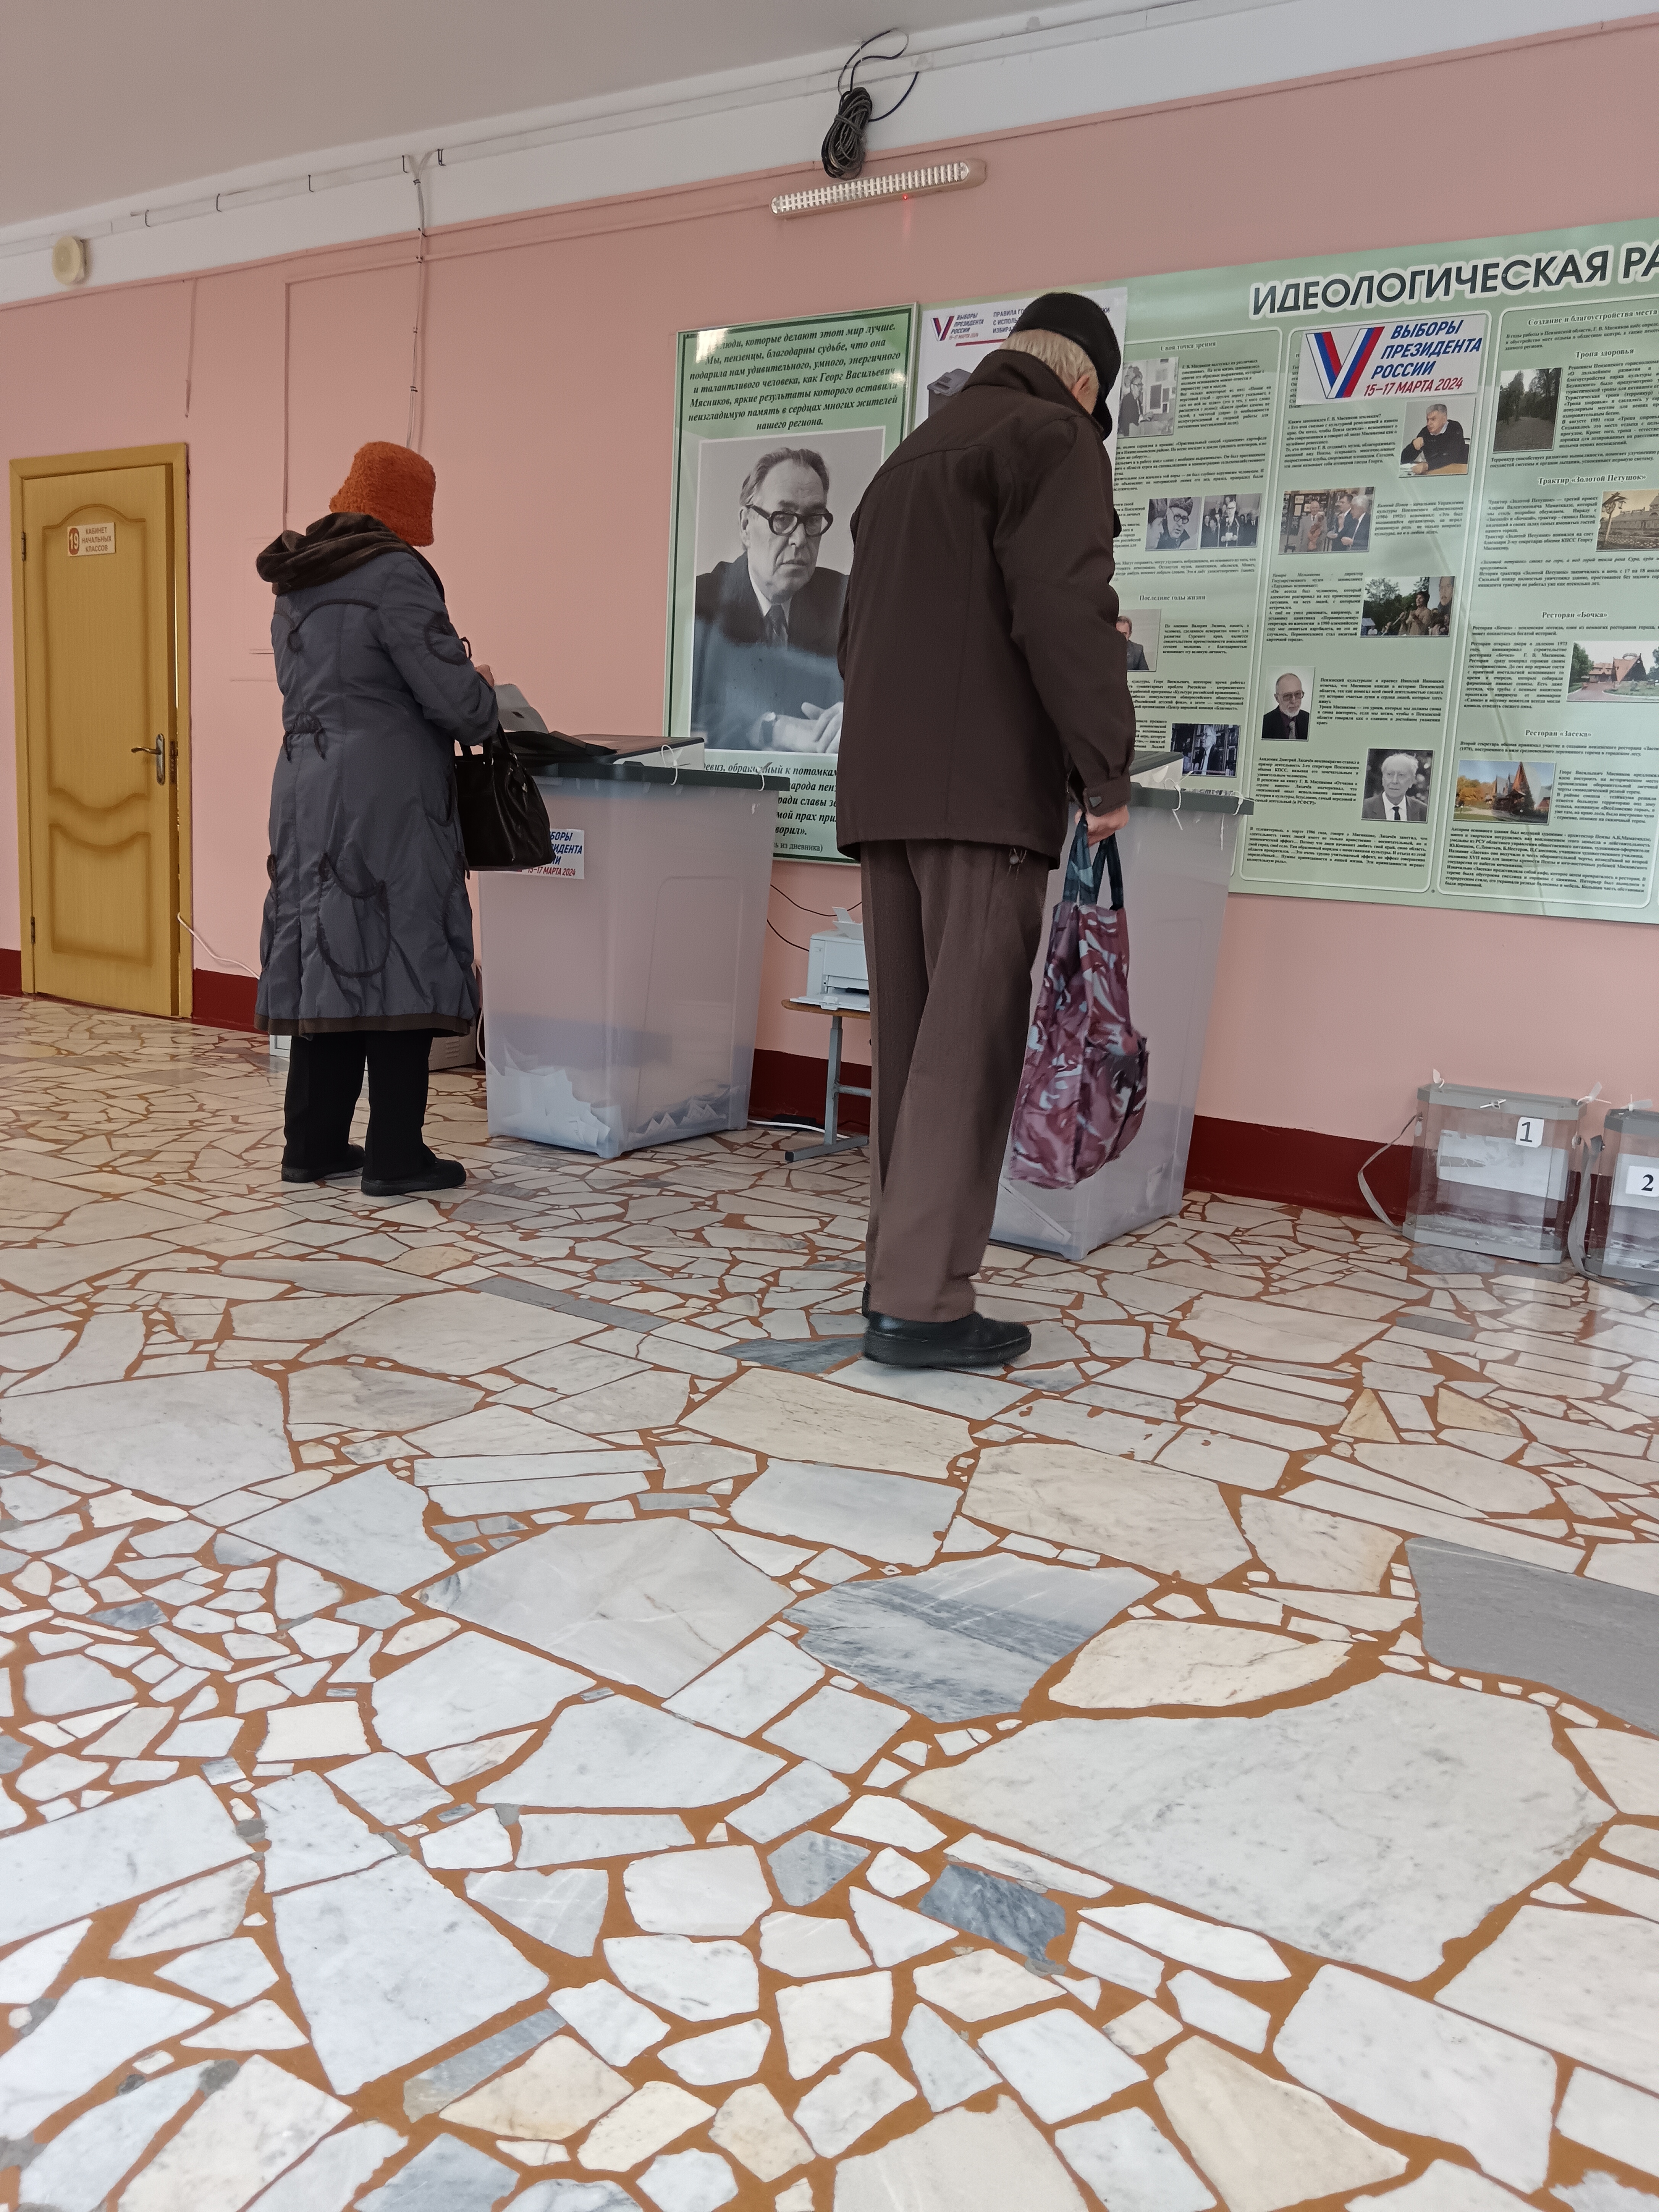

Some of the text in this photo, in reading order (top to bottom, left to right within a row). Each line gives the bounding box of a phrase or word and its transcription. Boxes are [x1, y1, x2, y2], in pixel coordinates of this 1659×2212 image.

[1253, 250, 1609, 315] ИДЕОЛОГИЧЕСКАЯ
[954, 319, 984, 327] ПРЕЗИДЕНТА
[1571, 312, 1633, 322] благоустройства
[745, 336, 782, 346] которые
[784, 332, 817, 342] делают
[820, 330, 844, 338] этот
[846, 327, 864, 337] мир
[865, 323, 895, 335] лучше.
[1391, 320, 1464, 339] ВЫБОРЫ
[724, 352, 764, 363] пензенцы,
[766, 347, 815, 358] благодарны
[817, 342, 847, 355] судьбе,
[870, 339, 886, 348] она
[1381, 338, 1482, 359] ПРЕЗИДЕНТА
[1577, 349, 1634, 359] Тропа здоровья
[689, 371, 728, 381] подарила
[746, 362, 811, 377] удивительного,
[813, 359, 846, 370] умного,
[849, 352, 901, 366] энергичного
[1371, 362, 1436, 379] РОССИИ
[701, 382, 760, 393] талантливого
[762, 378, 800, 387] человека,
[819, 372, 843, 383] Георг
[1364, 377, 1463, 396] 15–17 МАРТА 2024
[690, 384, 897, 407] Мясников, яркие результаты которого оставили
[688, 411, 745, 421] неизгладимую
[747, 408, 780, 417] память
[788, 403, 821, 415] сердцах
[823, 401, 855, 410] многих
[856, 395, 897, 407] жителей
[757, 419, 823, 430] нашего региона.
[70, 533, 79, 550] 19
[1525, 729, 1557, 737] Ресторан
[791, 781, 816, 792] арода
[800, 798, 826, 806] славы
[795, 813, 817, 823] прах
[819, 814, 836, 824] при
[550, 832, 573, 841] БОРЫ
[775, 826, 807, 836] ворил».
[789, 843, 823, 853] дневника)
[543, 867, 561, 875] МАРТА
[562, 868, 576, 876] 2024
[1520, 1122, 1533, 1143] 1
[1641, 1174, 1654, 1192] 2
